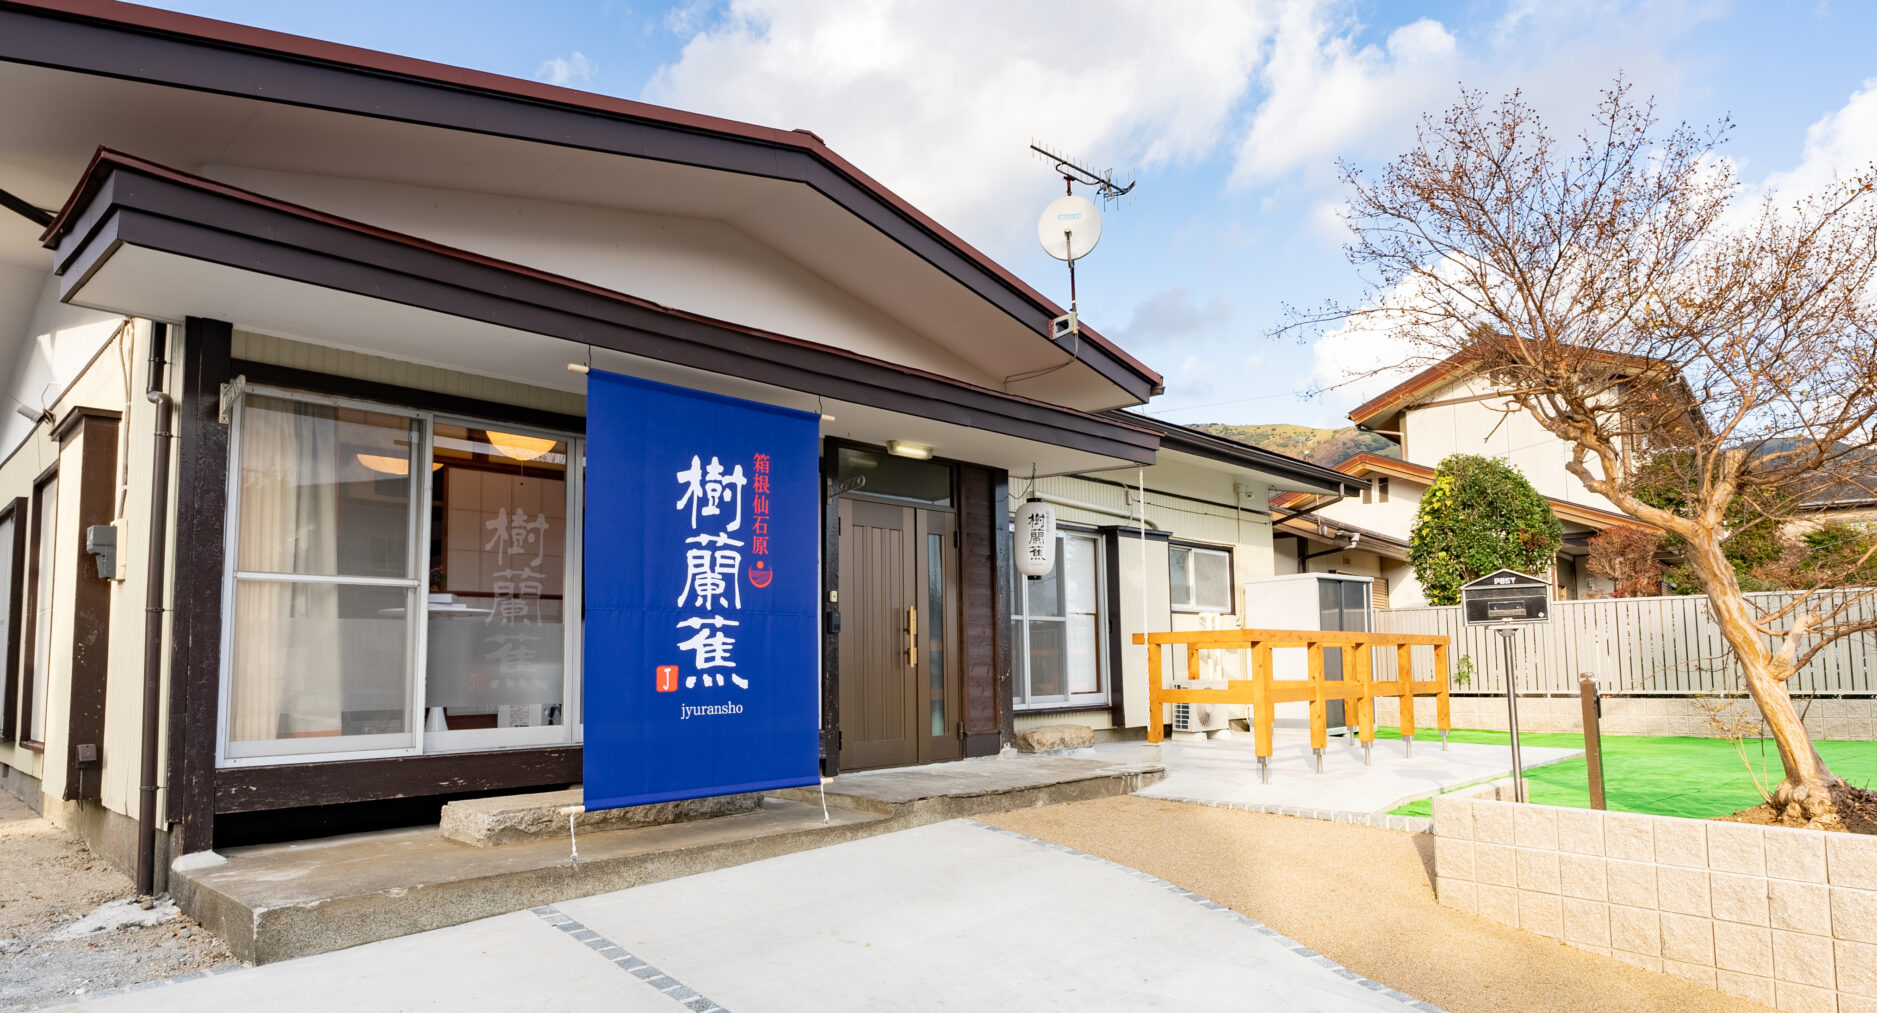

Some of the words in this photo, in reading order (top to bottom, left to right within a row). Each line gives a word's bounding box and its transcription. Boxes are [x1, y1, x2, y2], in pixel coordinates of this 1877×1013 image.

[751, 452, 771, 555] 箱根仙石原
[1029, 513, 1045, 560] 樹蘭蕉
[676, 454, 749, 690] 樹蘭蕉
[1494, 577, 1515, 585] POST
[680, 701, 744, 720] jyuransho
